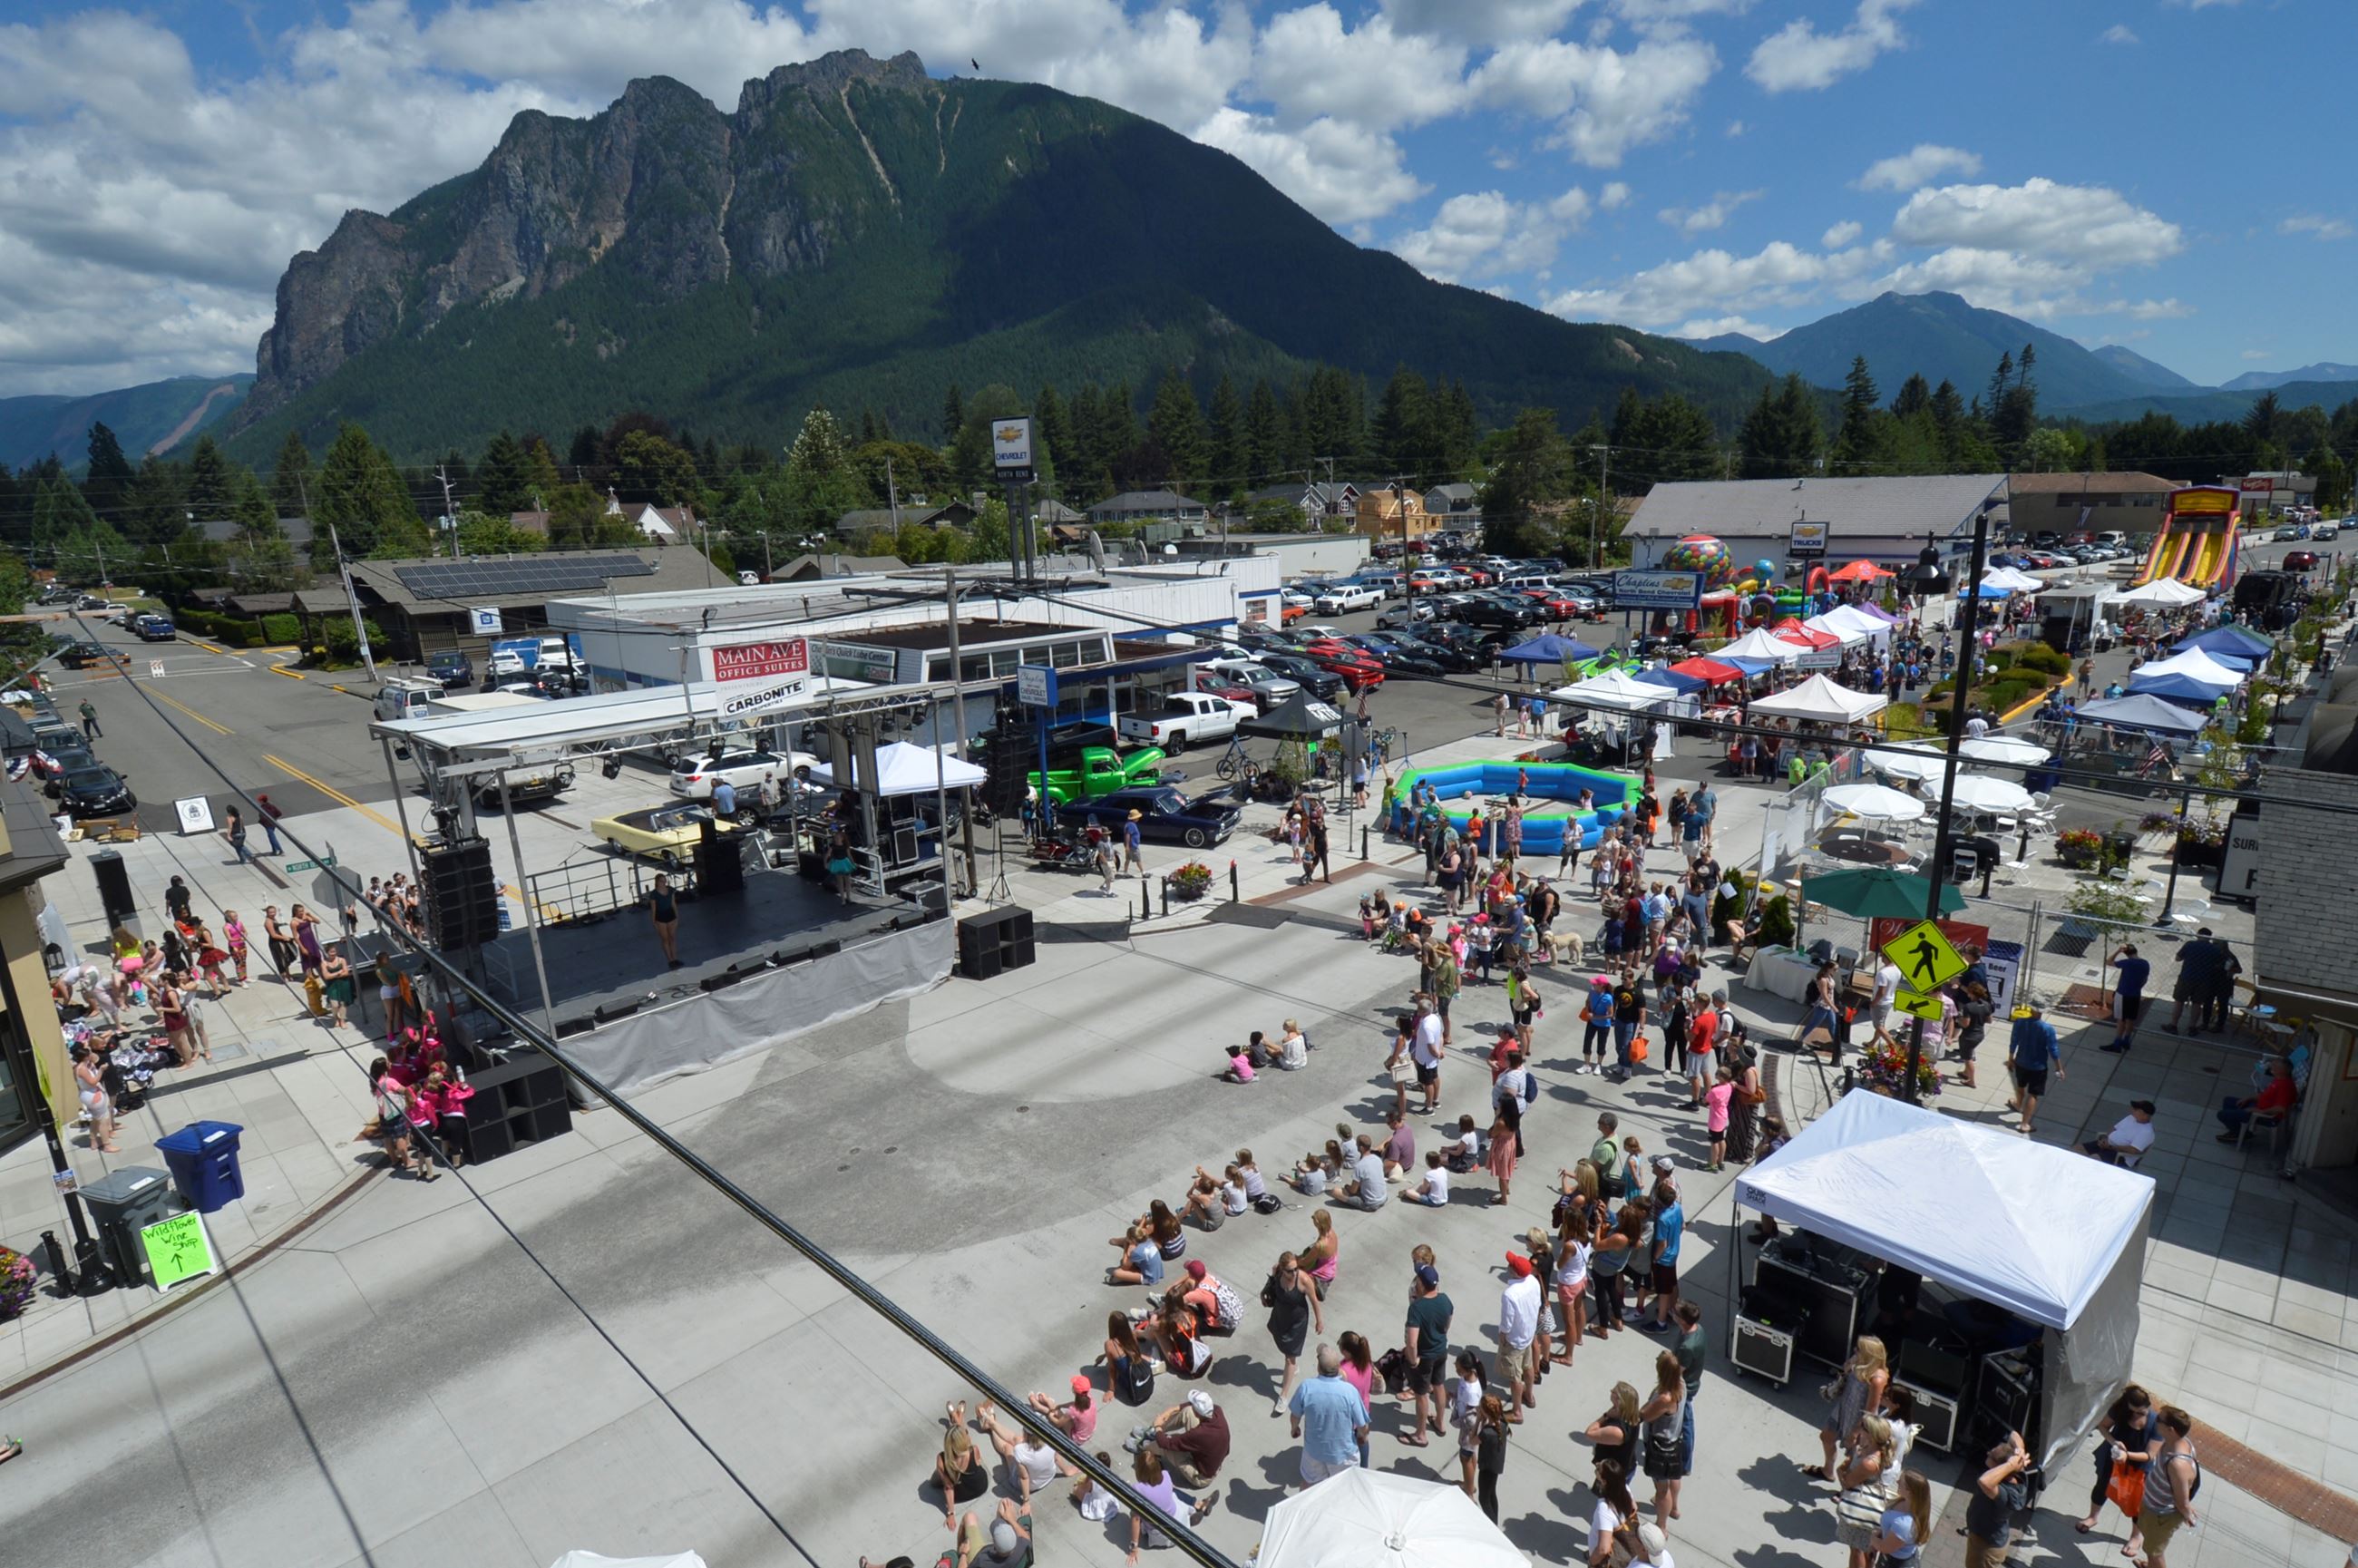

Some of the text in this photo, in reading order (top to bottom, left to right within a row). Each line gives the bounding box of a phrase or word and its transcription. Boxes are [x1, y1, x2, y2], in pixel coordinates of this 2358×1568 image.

[996, 452, 1027, 461] CHEVROLET
[1616, 574, 1661, 589] Chaplins
[717, 642, 803, 666] MAIN AVE
[836, 647, 853, 657] Quick
[853, 648, 868, 659] Lube
[869, 651, 889, 662] Center
[718, 660, 804, 678] OFFICE SUITES
[726, 681, 802, 714] CARBONITE
[1988, 962, 2007, 972] Beer
[1747, 1186, 1766, 1197] QUIK
[142, 1217, 196, 1239] Wildflower
[161, 1232, 188, 1244] Wine
[172, 1238, 198, 1251] Shop
